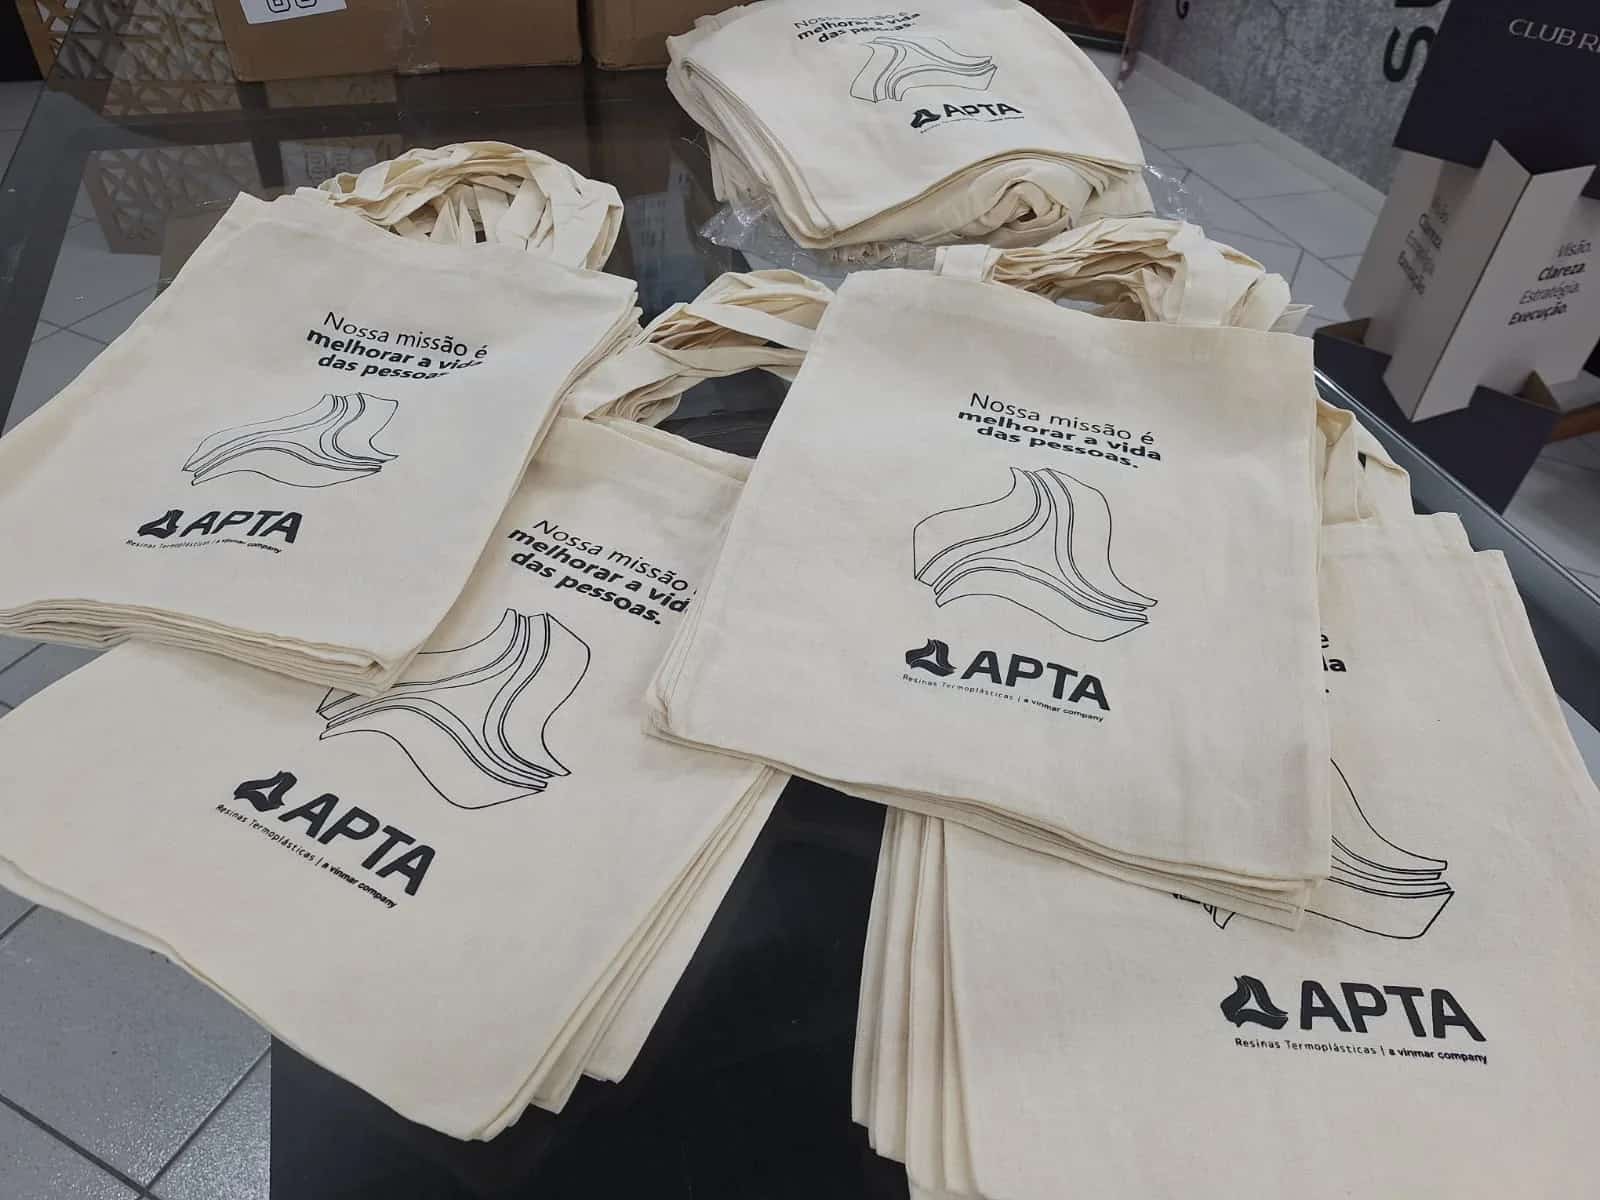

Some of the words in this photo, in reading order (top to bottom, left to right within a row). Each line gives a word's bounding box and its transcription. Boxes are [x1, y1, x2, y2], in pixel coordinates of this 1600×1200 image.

[818, 28, 848, 43] das
[1508, 18, 1577, 46] CLUB
[943, 103, 1023, 118] APTA
[306, 329, 415, 364] melhorar
[417, 357, 432, 368] a
[323, 311, 390, 343] Nossa
[395, 331, 468, 357] missão
[474, 344, 489, 359] é
[318, 354, 359, 372] das
[360, 363, 450, 380] pessoa
[957, 411, 1077, 441] melhorar
[1084, 436, 1098, 445] a
[1107, 440, 1161, 461] vida
[970, 392, 1041, 421] Nossa
[1049, 414, 1132, 440] missão
[1140, 432, 1155, 445] é
[977, 426, 1021, 443] das
[1029, 437, 1139, 469] pessoas.
[179, 510, 303, 544] APTA
[507, 529, 624, 583] melhorar
[624, 580, 643, 592] a
[648, 587, 691, 613] vid
[533, 520, 604, 556] Nossa
[607, 550, 689, 591] missão
[511, 552, 557, 578] das
[554, 575, 662, 625] pessoas.
[902, 673, 937, 687] Resinas
[1063, 709, 1104, 723] company
[960, 650, 1111, 711] APTA
[216, 804, 248, 823] Resinas
[358, 882, 398, 909] company
[277, 793, 436, 896] APTA
[1300, 980, 1488, 1042] APTA
[1234, 1037, 1281, 1049] Resinas
[1284, 1039, 1377, 1055] Termoplásticas
[1396, 1048, 1434, 1059] vinmar
[1437, 1051, 1488, 1065] company
